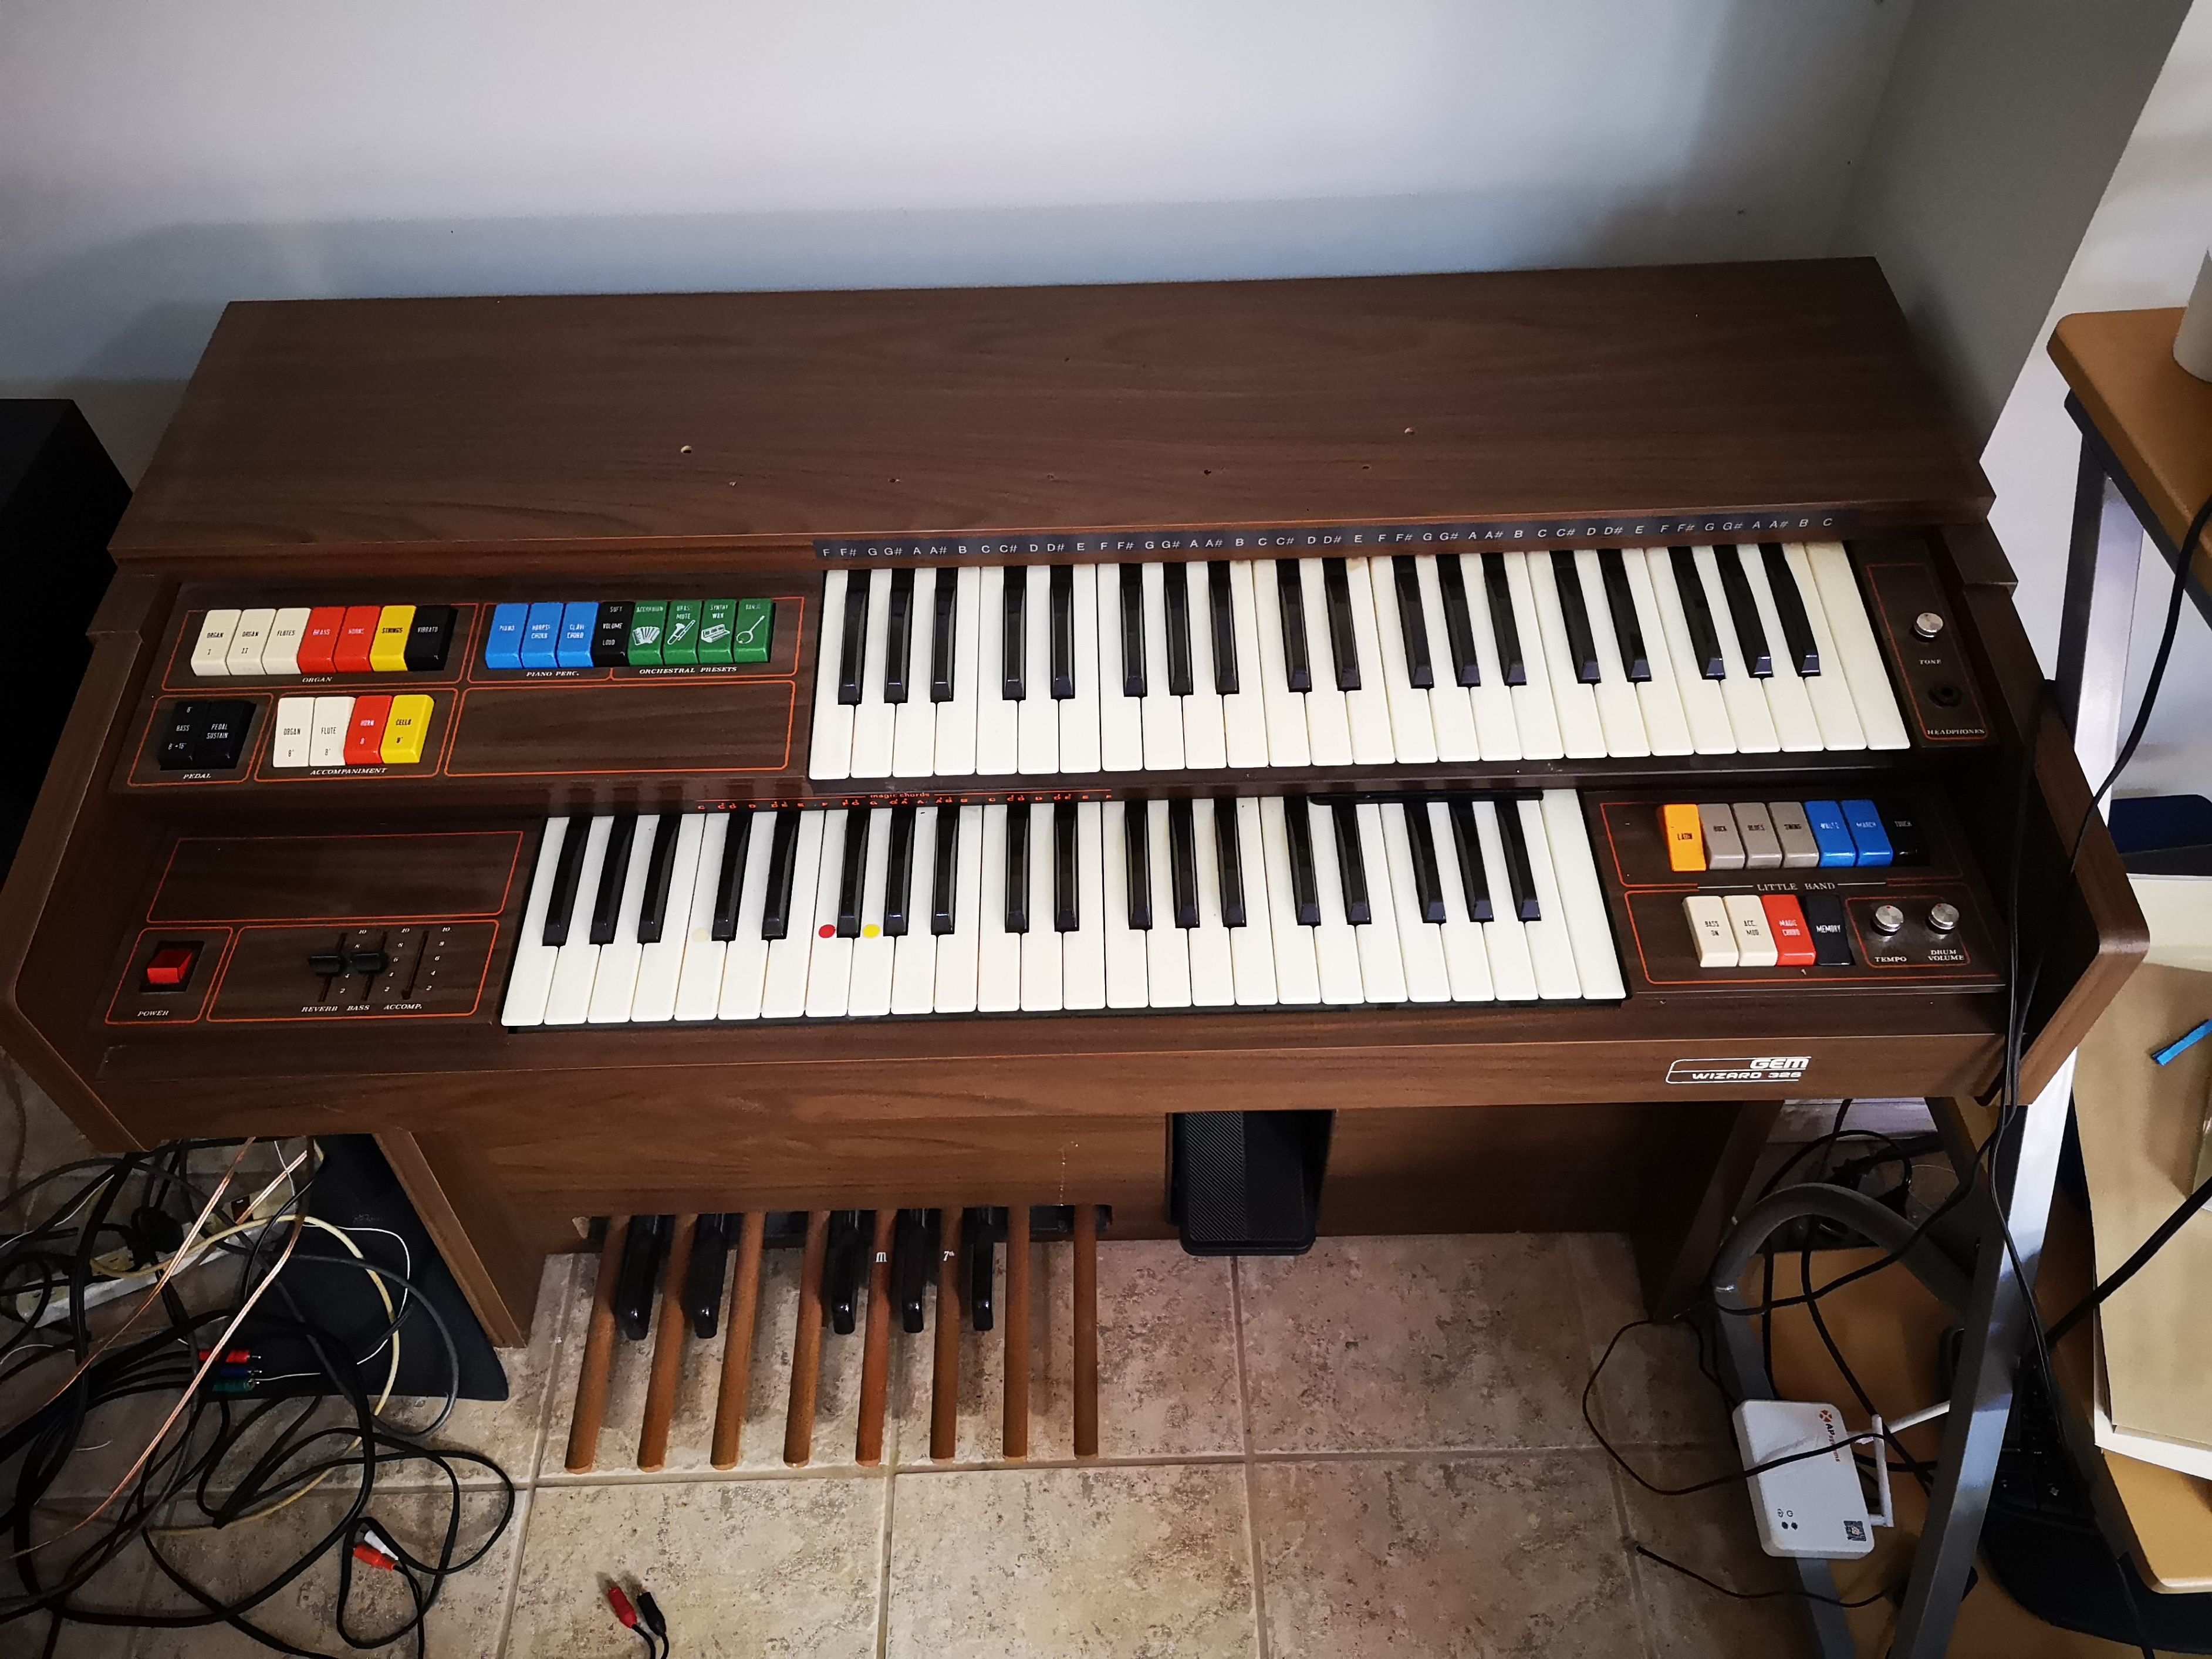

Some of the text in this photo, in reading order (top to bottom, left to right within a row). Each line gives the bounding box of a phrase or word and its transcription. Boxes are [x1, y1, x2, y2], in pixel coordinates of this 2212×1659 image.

[840, 548, 856, 556] F#
[867, 548, 877, 556] G
[884, 547, 903, 556] G#
[913, 546, 921, 555] A
[930, 546, 947, 555] A#
[958, 545, 967, 554] B
[981, 545, 990, 553] C
[999, 545, 1018, 553] C#
[1029, 543, 1038, 552] D
[1047, 543, 1065, 552] D#
[1076, 542, 1085, 551] E
[1100, 542, 1108, 550] F
[1117, 541, 1134, 550] F#
[1144, 540, 1154, 549] G
[1161, 540, 1180, 549] G#
[1190, 539, 1198, 548] A
[1205, 539, 1223, 548] A#
[1235, 538, 1244, 547] B
[1258, 538, 1267, 546] C
[1276, 537, 1294, 545] C#
[1307, 536, 1316, 544] D
[1323, 535, 1342, 544] D#
[1354, 535, 1363, 543] E
[1378, 534, 1386, 542] F
[1396, 533, 1413, 542] F#
[1423, 532, 1432, 541] G
[1439, 532, 1458, 540] G#
[1468, 532, 1477, 540] A
[1484, 531, 1504, 539] A#
[1514, 529, 1524, 539] B
[1537, 529, 1547, 538] C
[1556, 528, 1575, 537] C#
[1586, 528, 1596, 536] D
[1604, 526, 1623, 535] D#
[1635, 525, 1644, 534] E
[1660, 525, 1669, 533] F
[1677, 523, 1695, 532] F#
[1704, 523, 1714, 531] G
[1723, 522, 1743, 531] G#
[1769, 520, 1788, 528] A#
[1799, 519, 1809, 527] B
[1823, 518, 1832, 526] C
[1816, 925, 1840, 933] MEMORY
[1750, 1059, 1809, 1069] GEM
